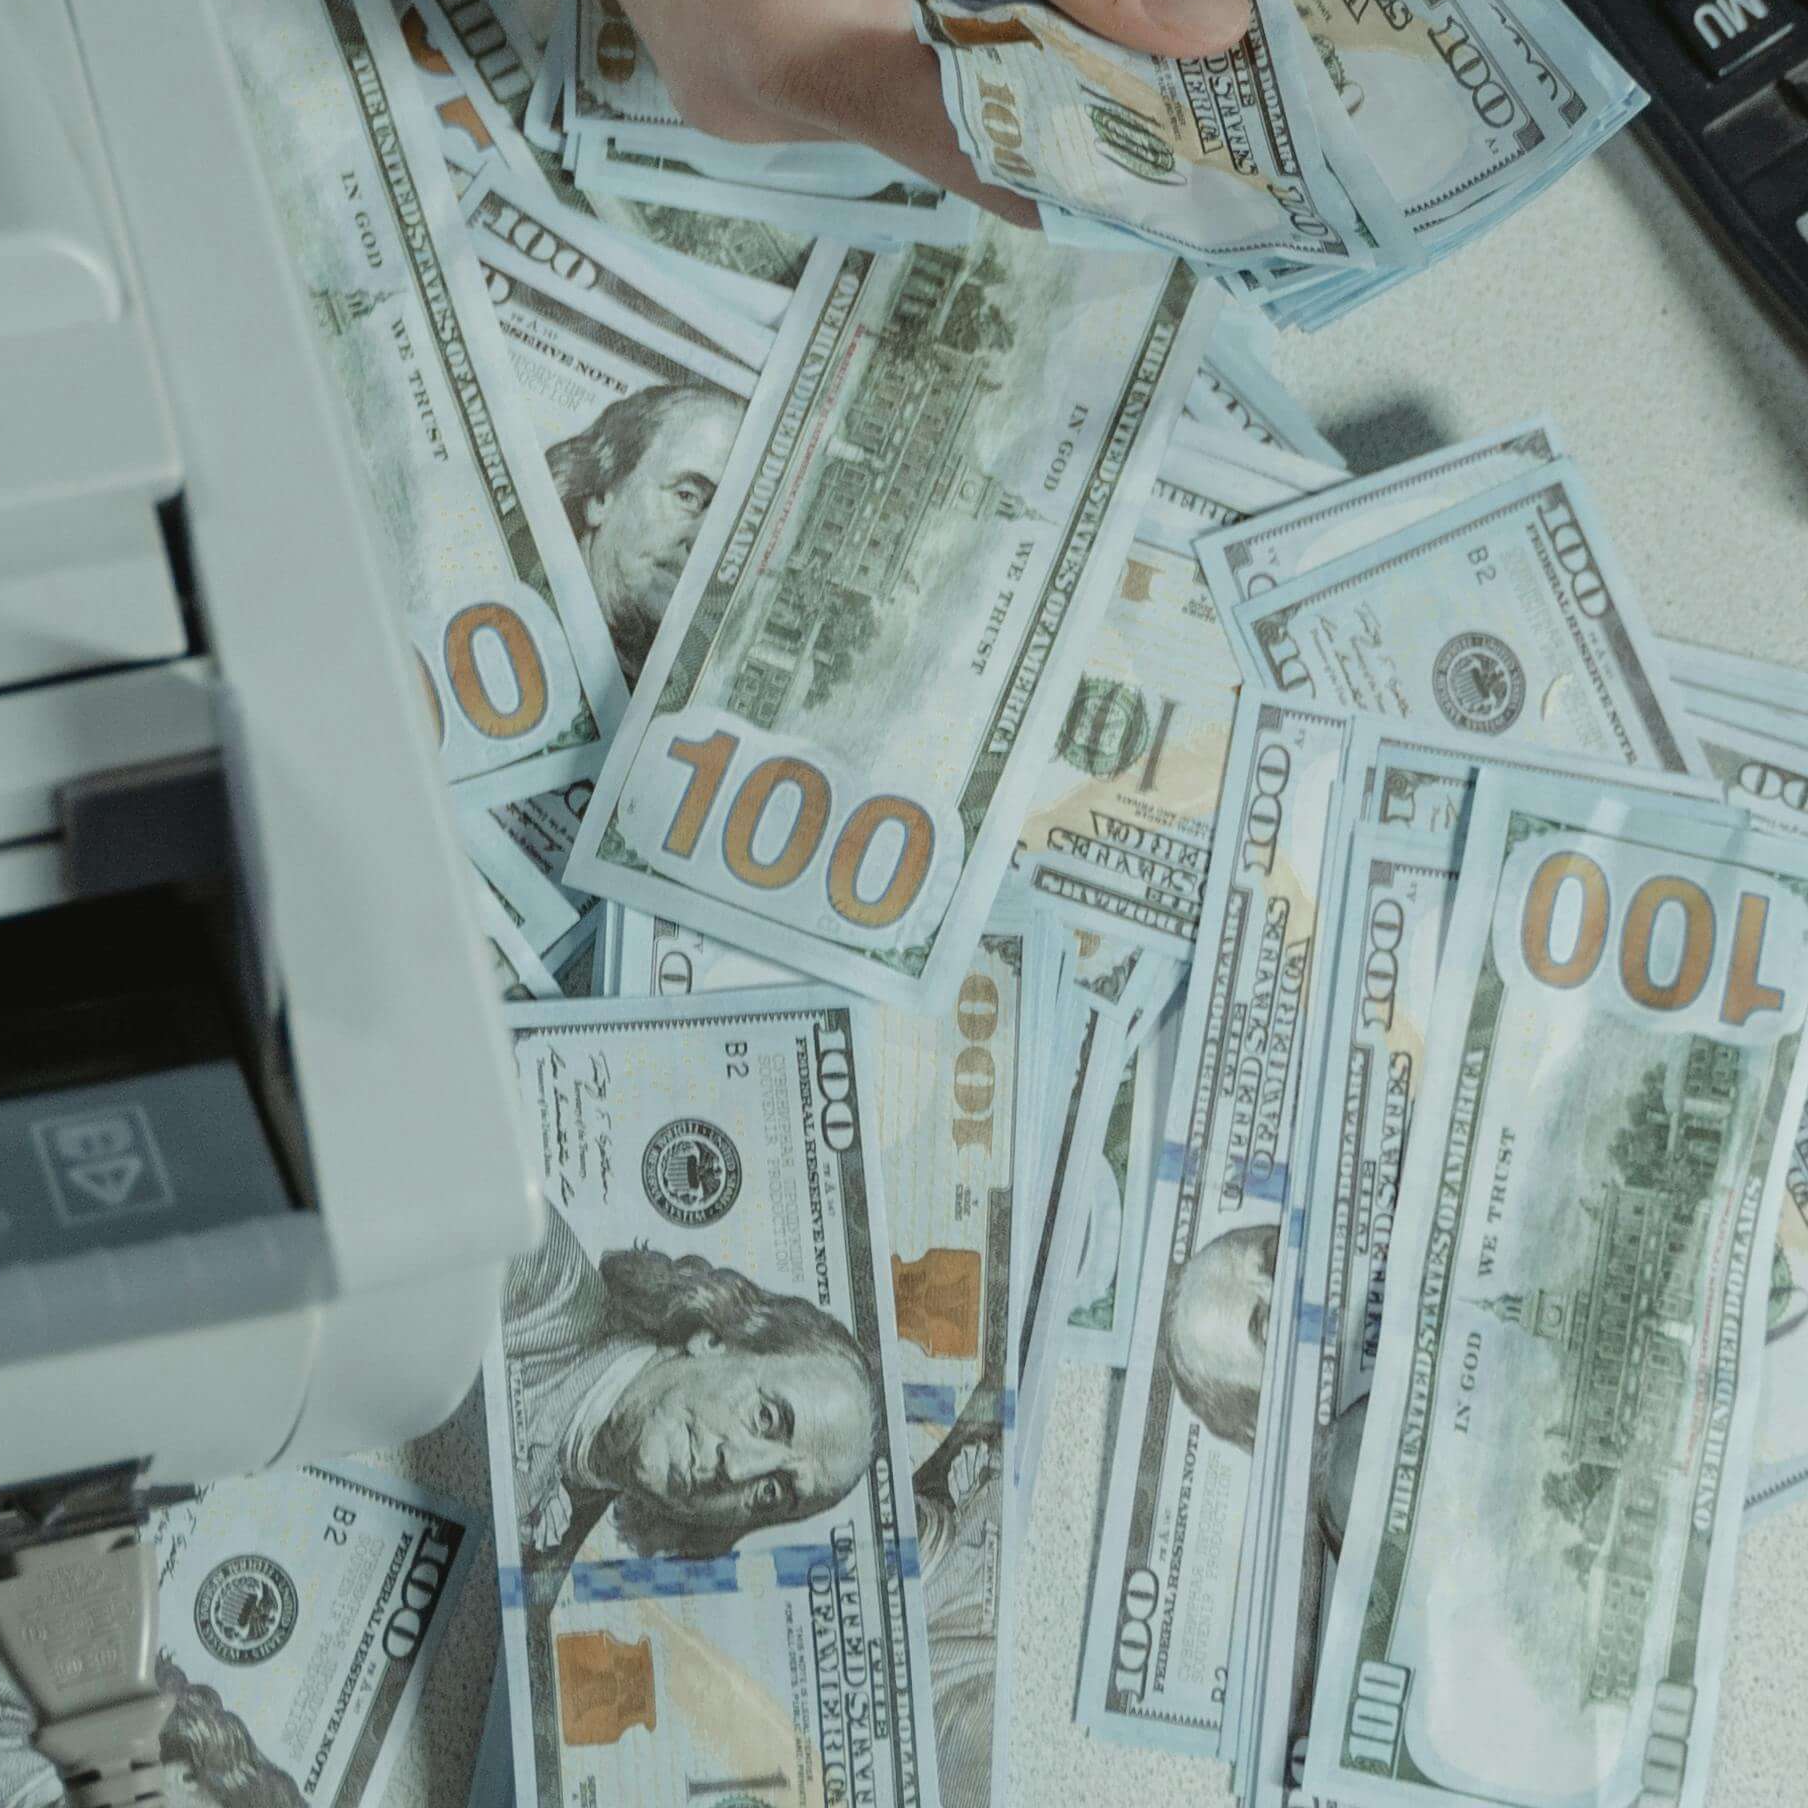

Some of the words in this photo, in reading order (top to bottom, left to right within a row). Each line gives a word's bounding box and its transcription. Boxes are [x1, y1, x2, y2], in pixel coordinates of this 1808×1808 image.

[346, 54, 385, 116] THE
[1426, 14, 1520, 132] 100
[339, 169, 363, 202] IN
[352, 209, 385, 270] GOD
[365, 113, 422, 226] UNITED
[403, 223, 461, 340] STATES
[481, 199, 605, 293] 100
[820, 270, 861, 331] ONE
[1136, 320, 1178, 383] THE
[388, 318, 416, 360] WE
[405, 368, 451, 464] TRUST
[442, 338, 475, 381] OF
[765, 327, 838, 464] HUNDRED
[454, 375, 520, 516] AMERICA
[1094, 377, 1154, 484] UNITED
[714, 459, 783, 587] DOLLARS
[1005, 537, 1034, 581] WE
[1047, 478, 1113, 599] STATES
[1463, 545, 1498, 587] B2
[1522, 521, 1573, 614] FEDERAL
[1534, 495, 1614, 623] 100
[968, 587, 1013, 677] TRUST
[982, 627, 1052, 757] AMERICA
[676, 735, 931, 918] 100
[1239, 741, 1294, 878] 100
[1356, 897, 1408, 1032] 100
[1526, 867, 1780, 1020] 100
[723, 1040, 748, 1079] B2
[793, 1036, 815, 1135] FEDERAL
[810, 1020, 856, 1152] 100
[951, 973, 1000, 1157] 100
[1172, 1201, 1195, 1263] ONE
[1206, 894, 1242, 1038] DOLLARS
[1217, 1057, 1265, 1214] UNITED
[1243, 895, 1291, 1053] STATES
[1220, 1003, 1245, 1096] THE
[1442, 1046, 1487, 1185] AMERICA
[802, 1139, 824, 1244] RESERVE
[1354, 1159, 1376, 1253] THE
[1434, 1184, 1464, 1230] OF
[1486, 1126, 1518, 1224] TRUST
[812, 1248, 830, 1305] NOTE
[1414, 1230, 1457, 1353] STATES
[1477, 1232, 1500, 1278] WE
[1722, 1174, 1763, 1316] DOLLARS
[1395, 1352, 1437, 1468] UNITED
[1458, 1330, 1482, 1391] GOD
[1701, 1318, 1745, 1465] HUNDRED
[1452, 1400, 1472, 1433] IN
[322, 1505, 356, 1548] B2
[1385, 1468, 1418, 1533] THE
[1691, 1467, 1722, 1530] ONE
[365, 1531, 414, 1632] FEDERAL
[378, 1525, 452, 1665] 100
[1152, 1593, 1178, 1692] FEDERAL
[1166, 1485, 1193, 1591] RESERVE
[1181, 1422, 1202, 1482] NOTE
[326, 1631, 375, 1732] RESERVE
[1110, 1566, 1162, 1702] 100
[867, 1638, 889, 1739] THE
[1346, 1660, 1406, 1765] 100
[302, 1732, 336, 1795] NOTE
